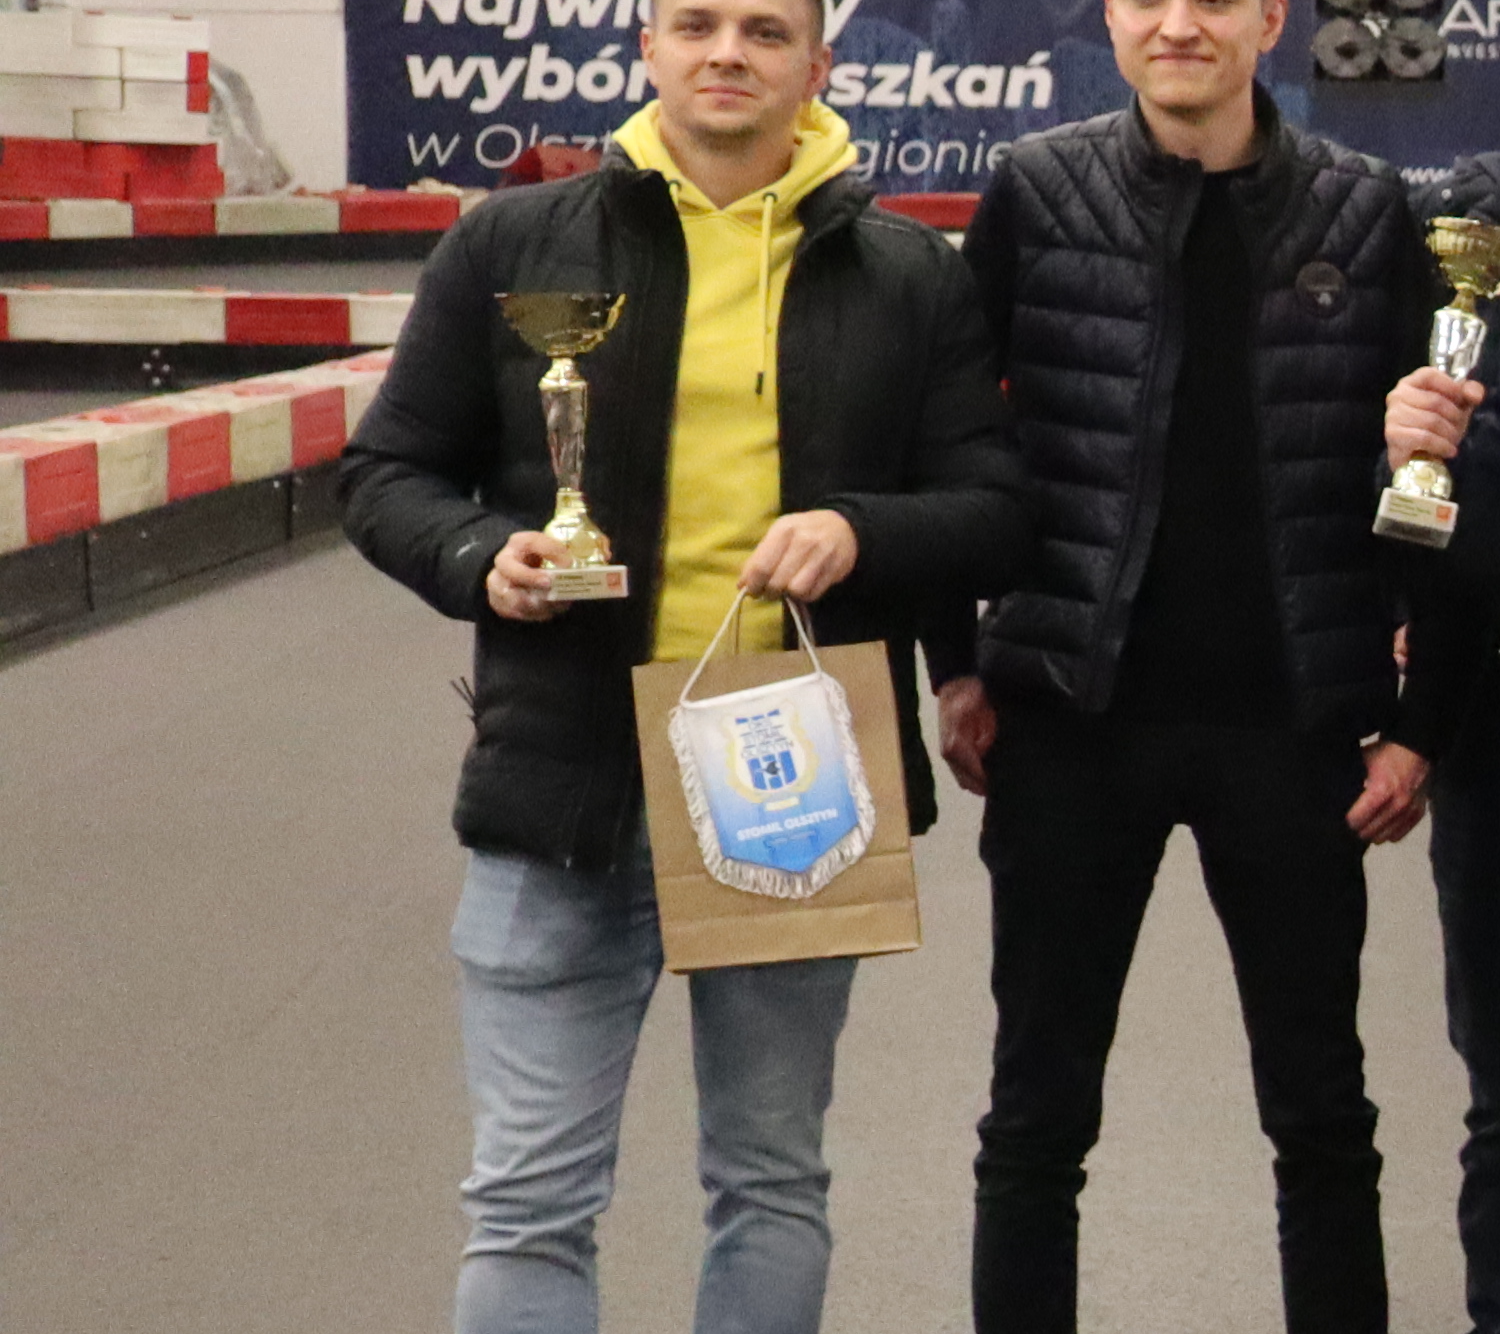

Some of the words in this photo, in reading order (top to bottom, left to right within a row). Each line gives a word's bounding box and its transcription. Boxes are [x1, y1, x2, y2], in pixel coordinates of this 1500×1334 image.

[825, 50, 1054, 110] szkań
[407, 131, 461, 168] w
[849, 128, 1014, 182] gionie
